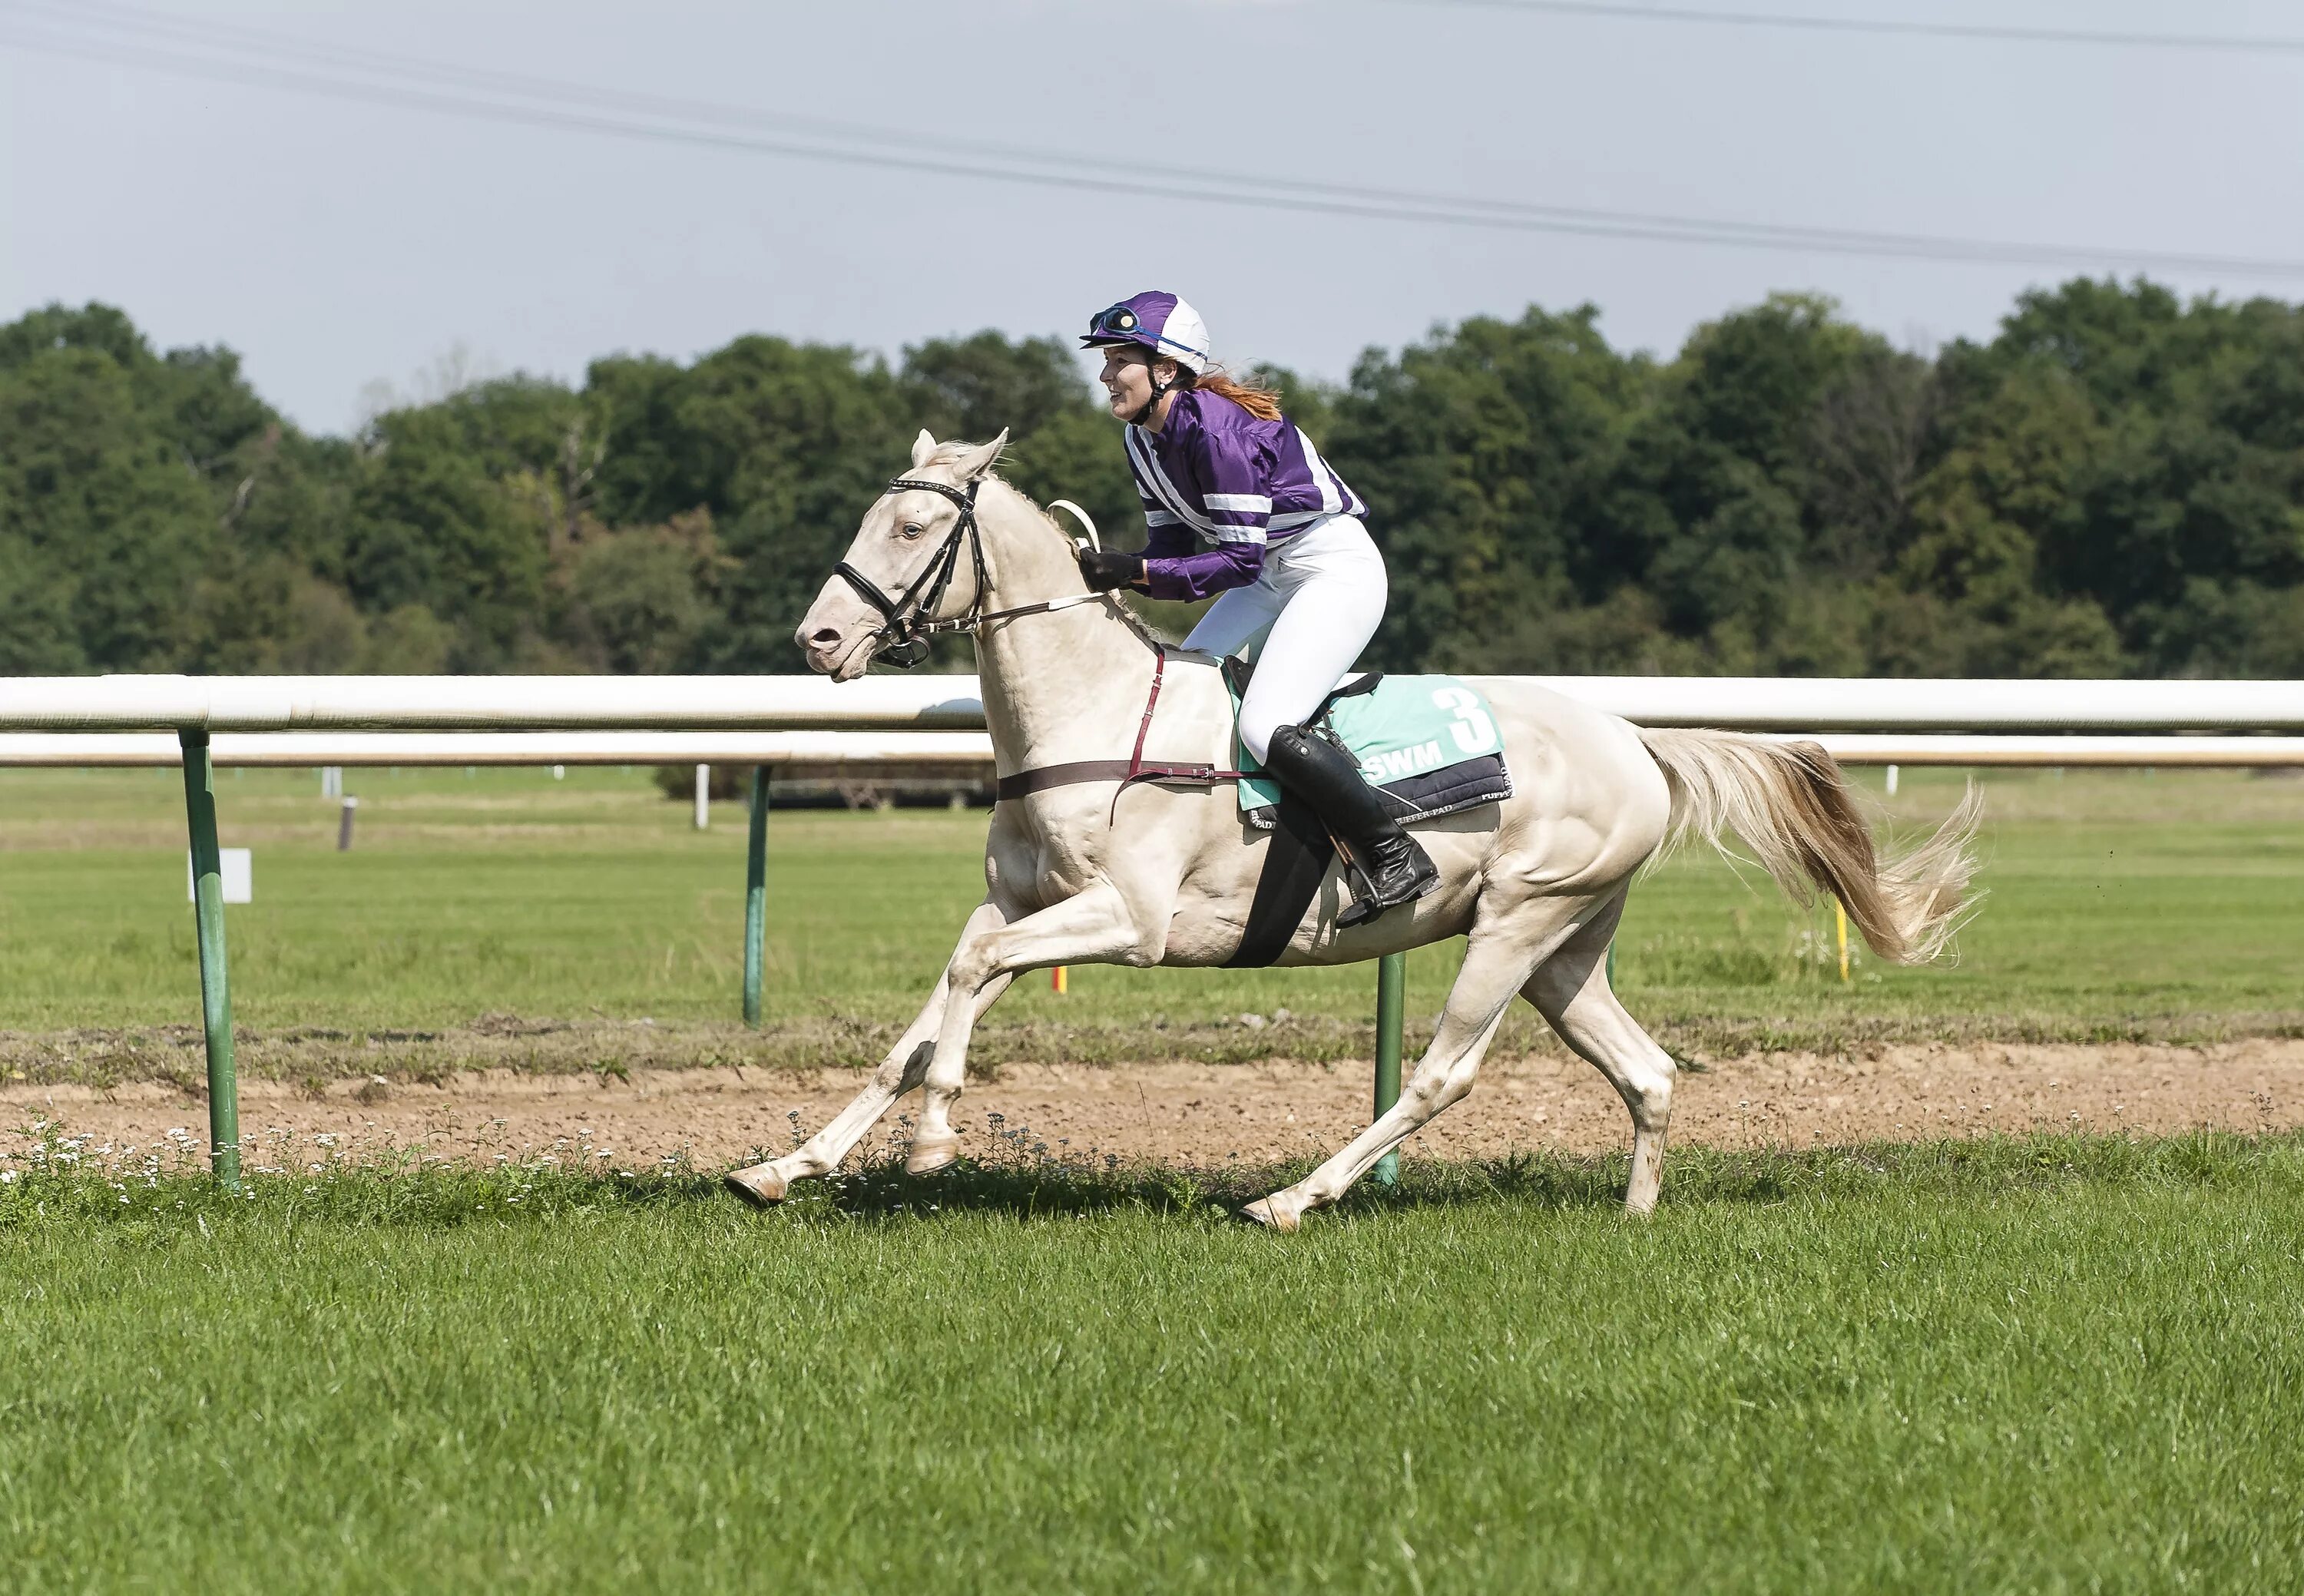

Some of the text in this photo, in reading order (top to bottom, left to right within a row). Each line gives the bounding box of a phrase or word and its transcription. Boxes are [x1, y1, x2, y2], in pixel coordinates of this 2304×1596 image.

[1432, 687, 1497, 753] 3
[1361, 740, 1444, 782] SWM
[1394, 804, 1453, 826] PUFFER-PAD
